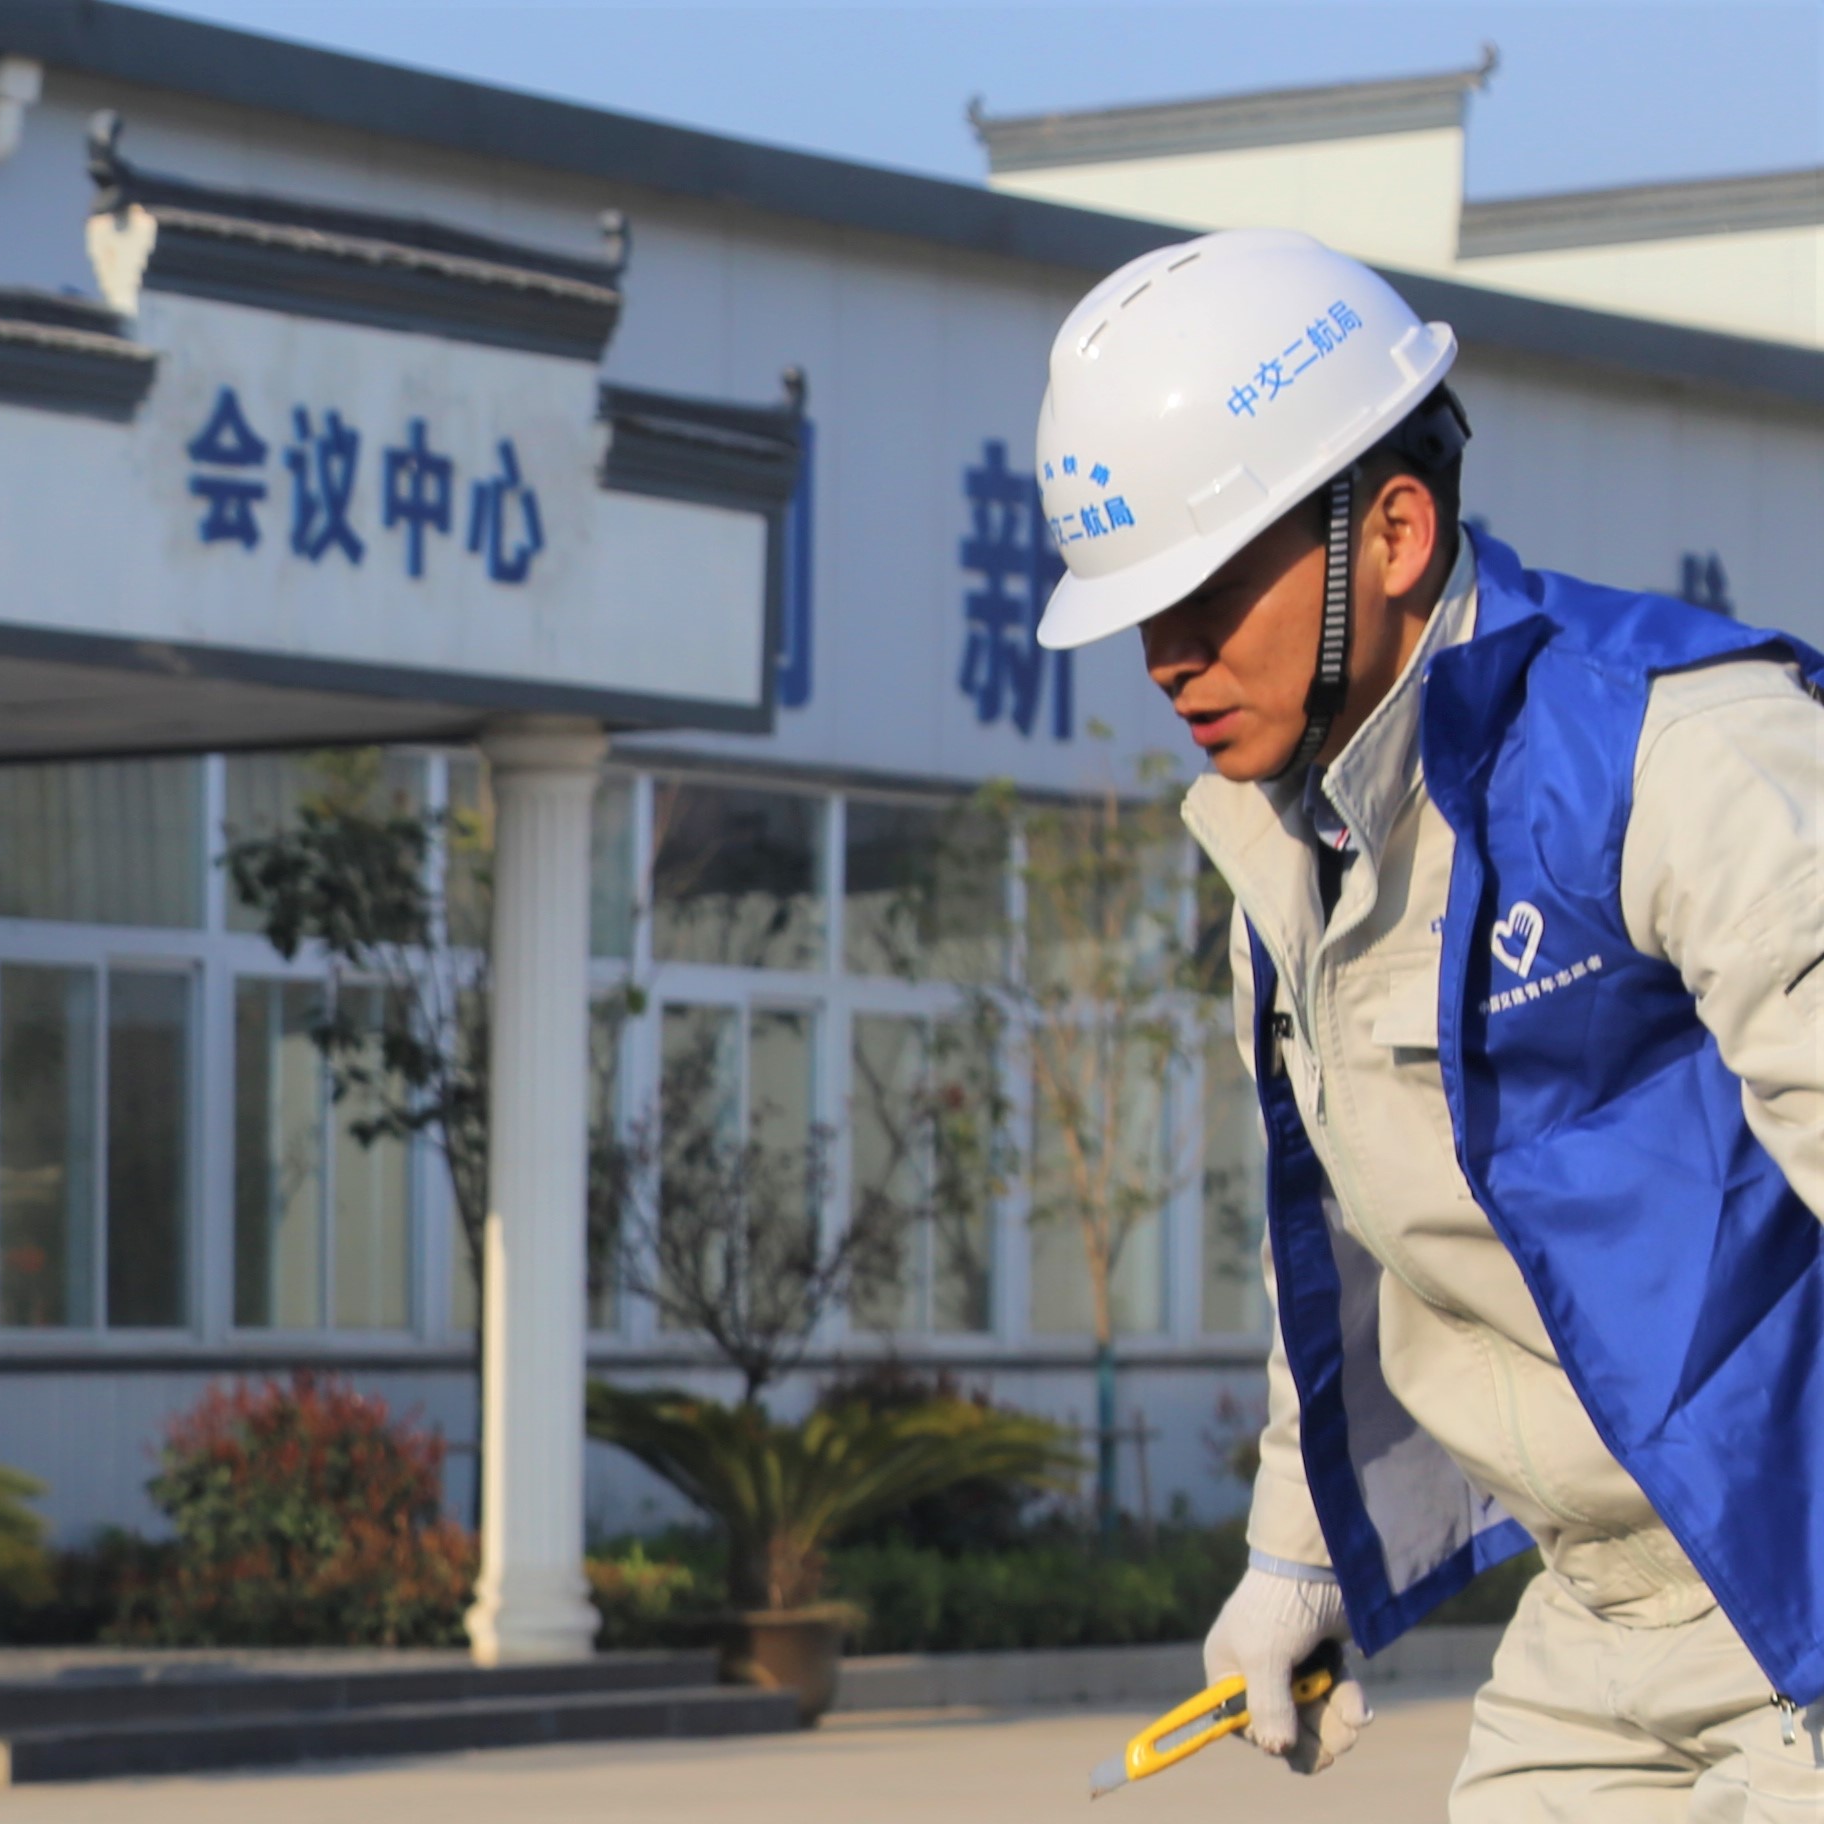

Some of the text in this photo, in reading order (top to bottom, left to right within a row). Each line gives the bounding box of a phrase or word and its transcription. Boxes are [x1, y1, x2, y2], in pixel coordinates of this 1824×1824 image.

[1227, 300, 1363, 418] 中交二航局
[186, 385, 546, 586] 会议中心
